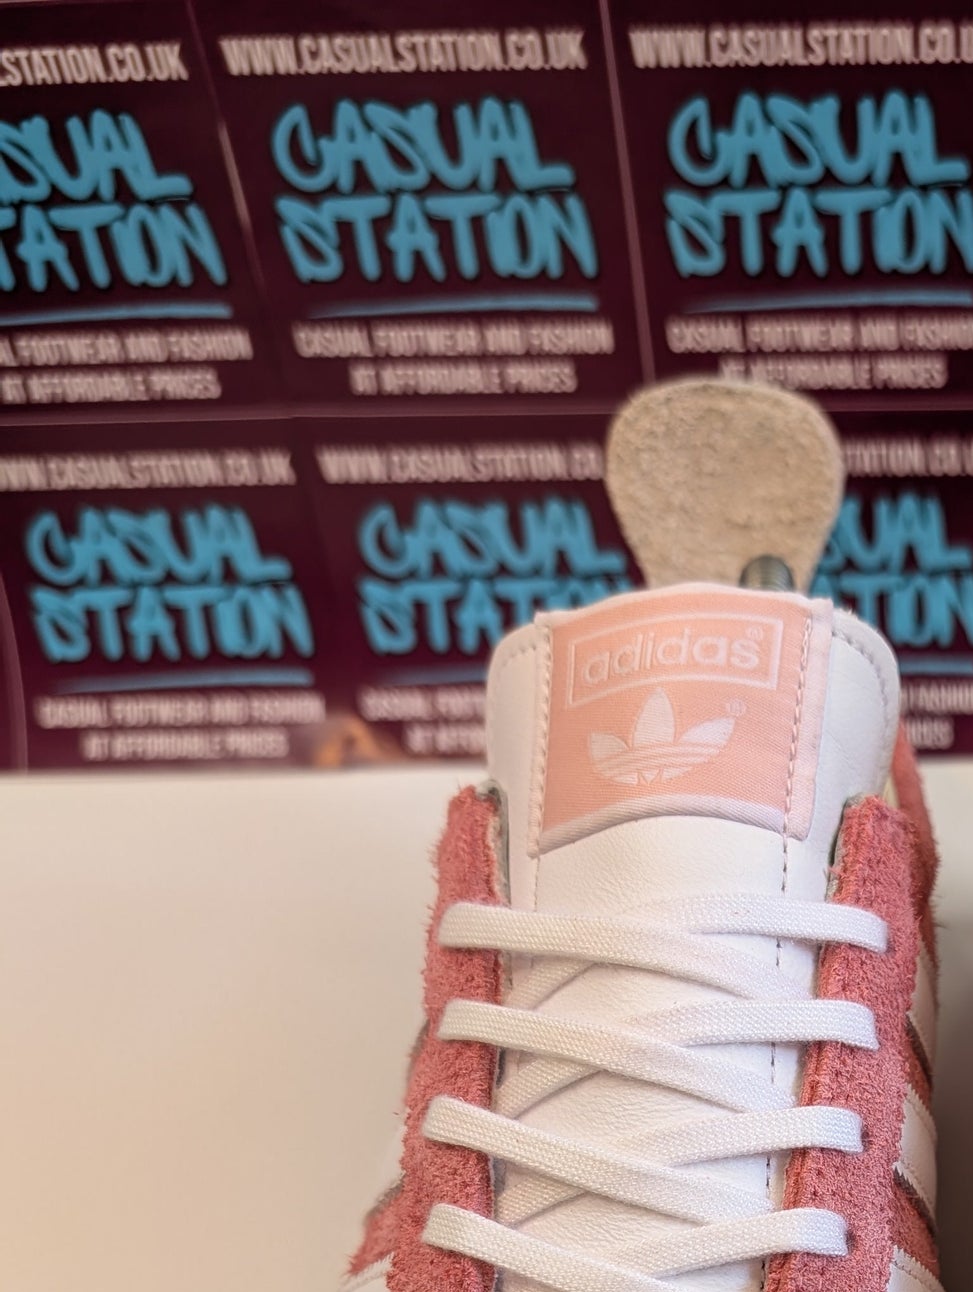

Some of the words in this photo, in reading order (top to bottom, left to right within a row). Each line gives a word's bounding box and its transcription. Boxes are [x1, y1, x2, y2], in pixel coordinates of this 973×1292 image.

[218, 30, 588, 76] WWW.CASUALSTATION.CO.UK
[272, 97, 575, 194] CASUAL
[668, 90, 970, 187] CASUAL
[276, 195, 598, 283] STATION
[26, 504, 291, 587] CASUAL
[359, 497, 626, 578] CASUAL
[29, 581, 314, 662] STATION
[583, 626, 761, 685] adidas
